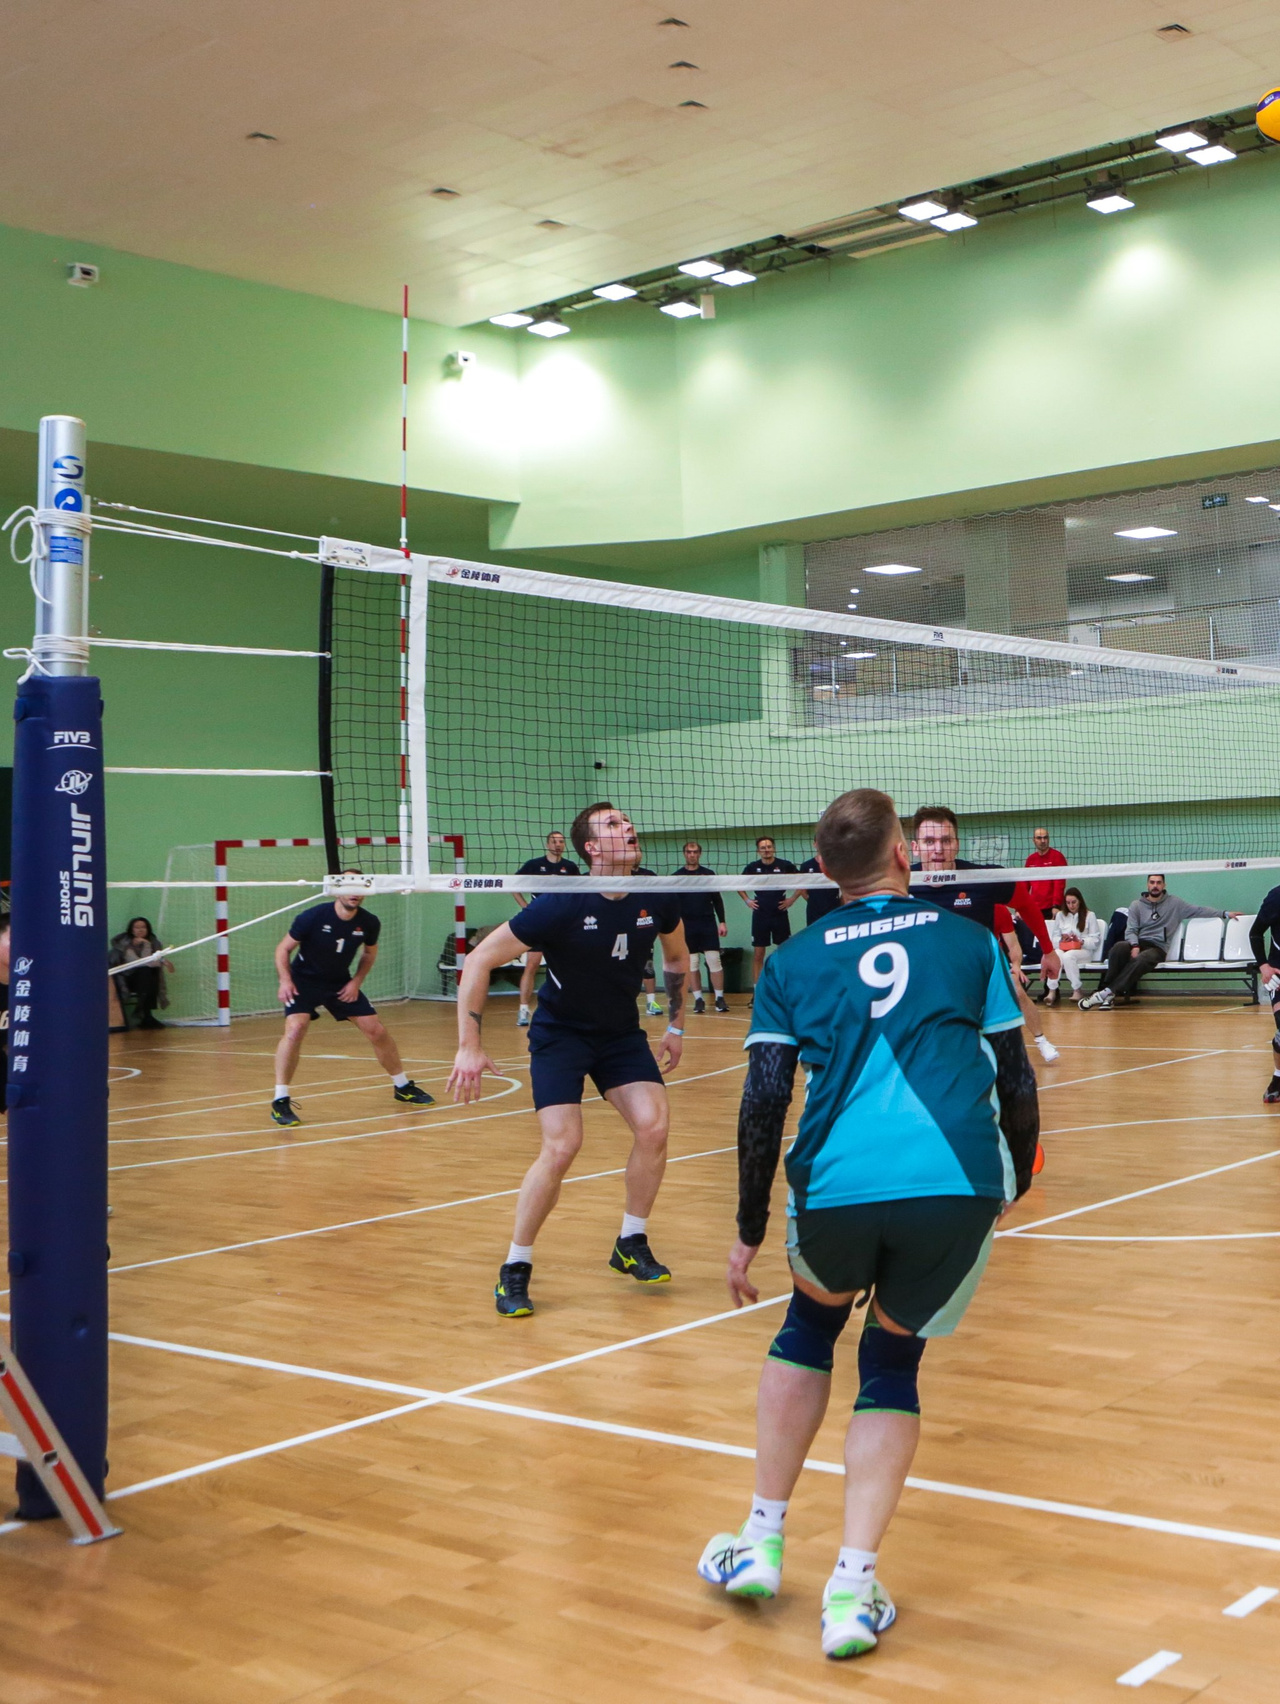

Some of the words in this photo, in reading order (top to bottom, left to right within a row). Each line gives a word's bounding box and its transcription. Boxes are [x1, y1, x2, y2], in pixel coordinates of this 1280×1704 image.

[53, 731, 91, 744] FIVB
[59, 871, 71, 925] SPORTS
[824, 911, 939, 945] СИБУР
[336, 938, 345, 953] 1
[611, 933, 629, 961] 4
[858, 941, 910, 1019] 9
[12, 980, 32, 1073] 金陵体育
